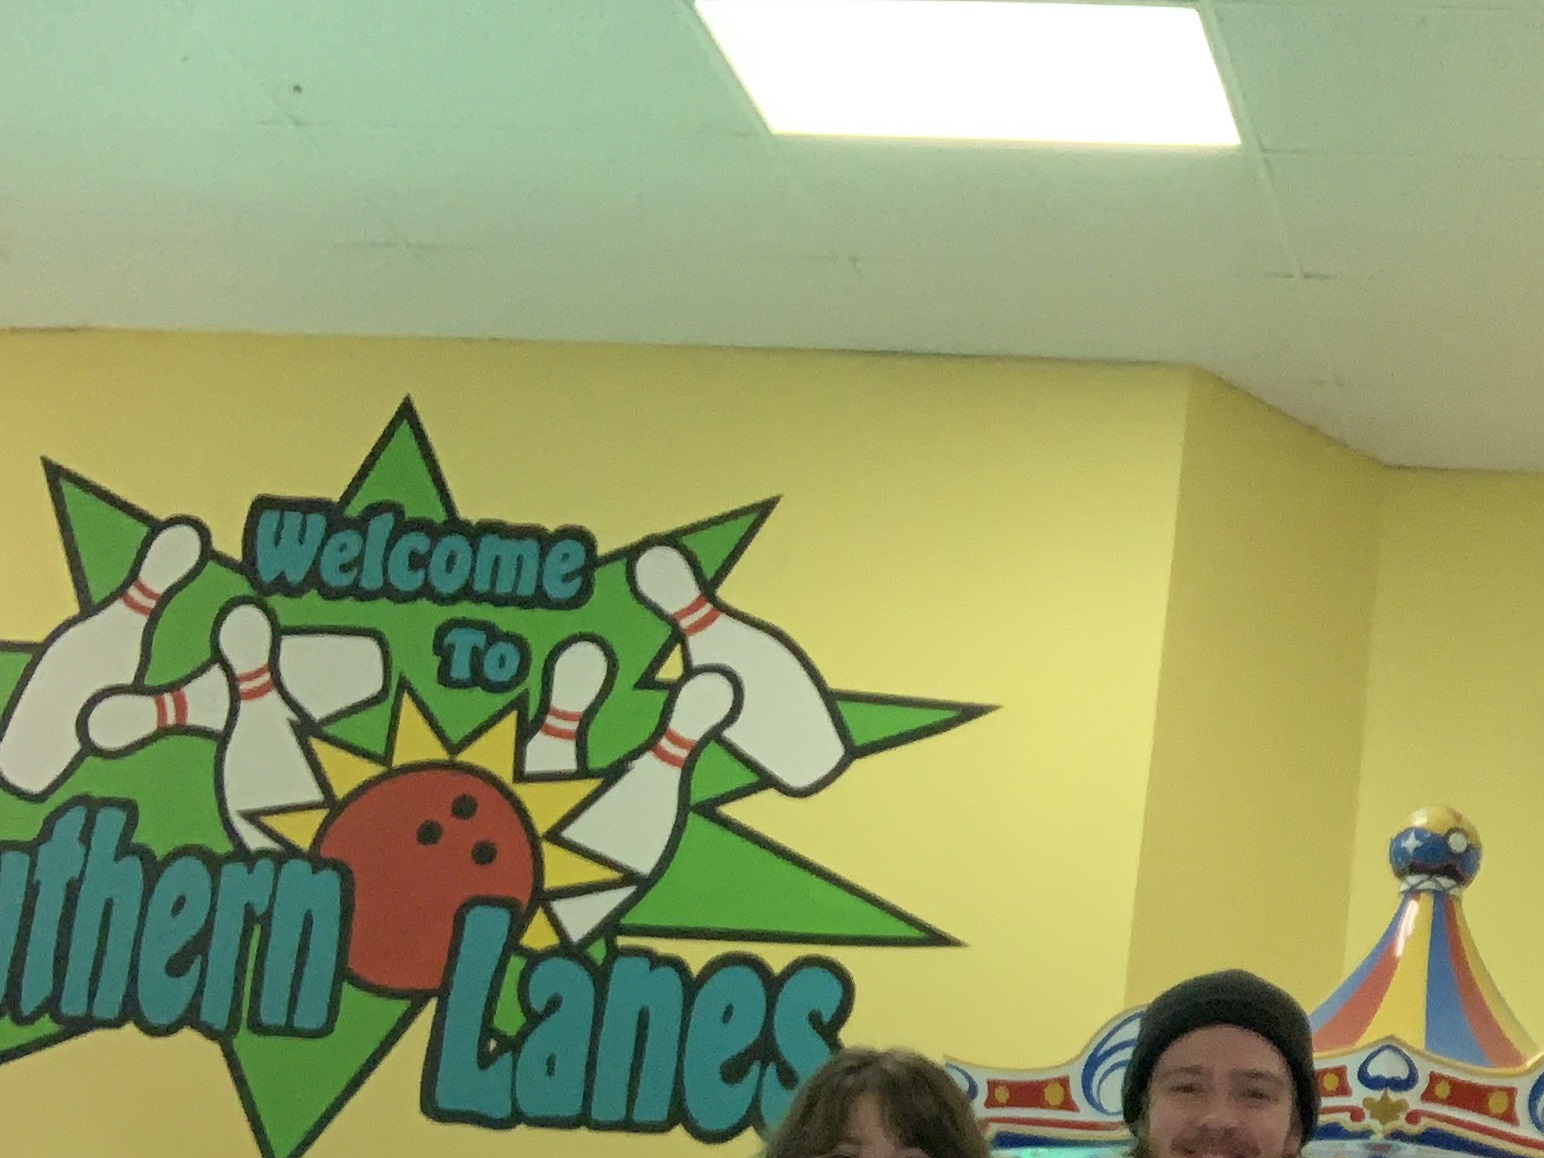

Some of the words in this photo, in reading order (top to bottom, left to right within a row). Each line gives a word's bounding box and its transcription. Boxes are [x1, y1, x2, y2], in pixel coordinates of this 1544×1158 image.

[251, 503, 592, 606] Welcome
[439, 624, 525, 686] To
[430, 901, 849, 1135] Lanes
